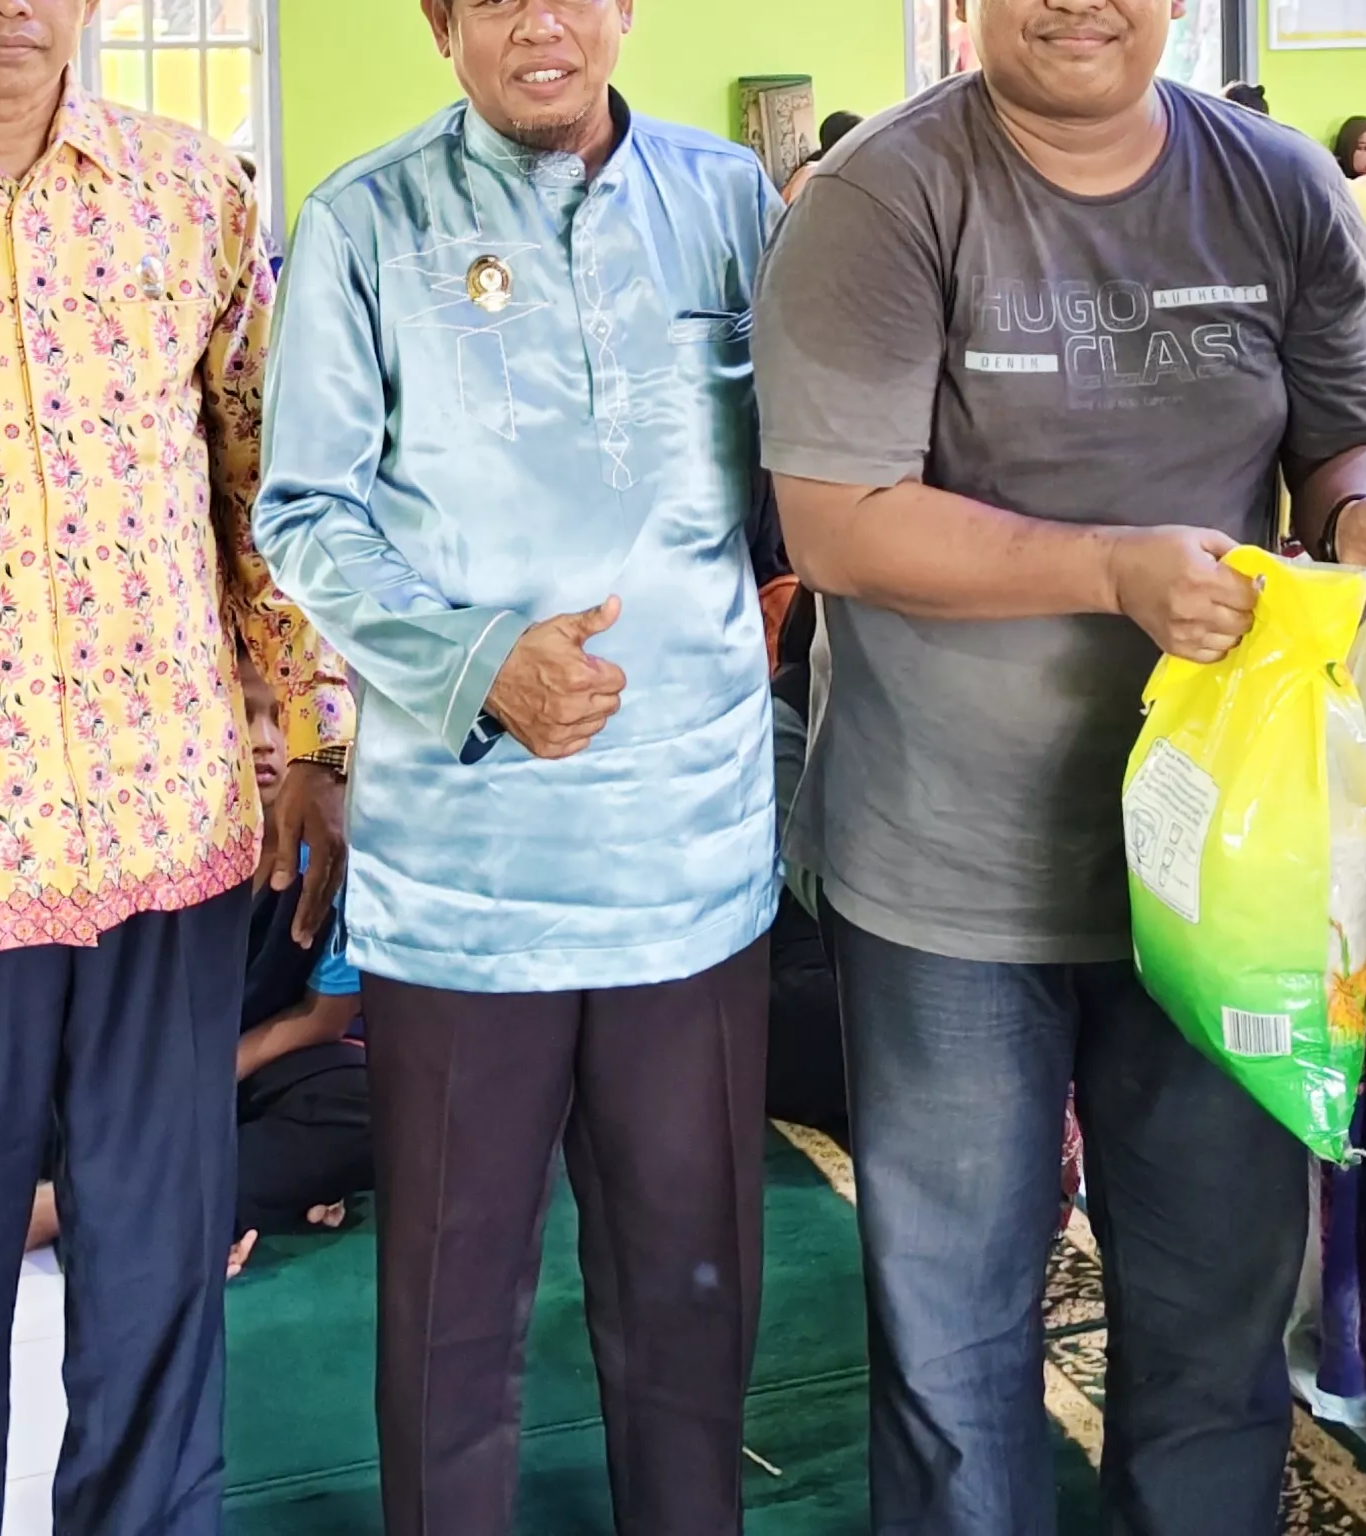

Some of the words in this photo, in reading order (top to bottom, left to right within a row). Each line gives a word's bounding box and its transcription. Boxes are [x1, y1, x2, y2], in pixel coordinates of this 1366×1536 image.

[971, 275, 1150, 334] HUGO
[1159, 286, 1263, 305] AUTHENTIC
[980, 355, 1039, 369] DENIM
[1064, 322, 1249, 390] CLAS
